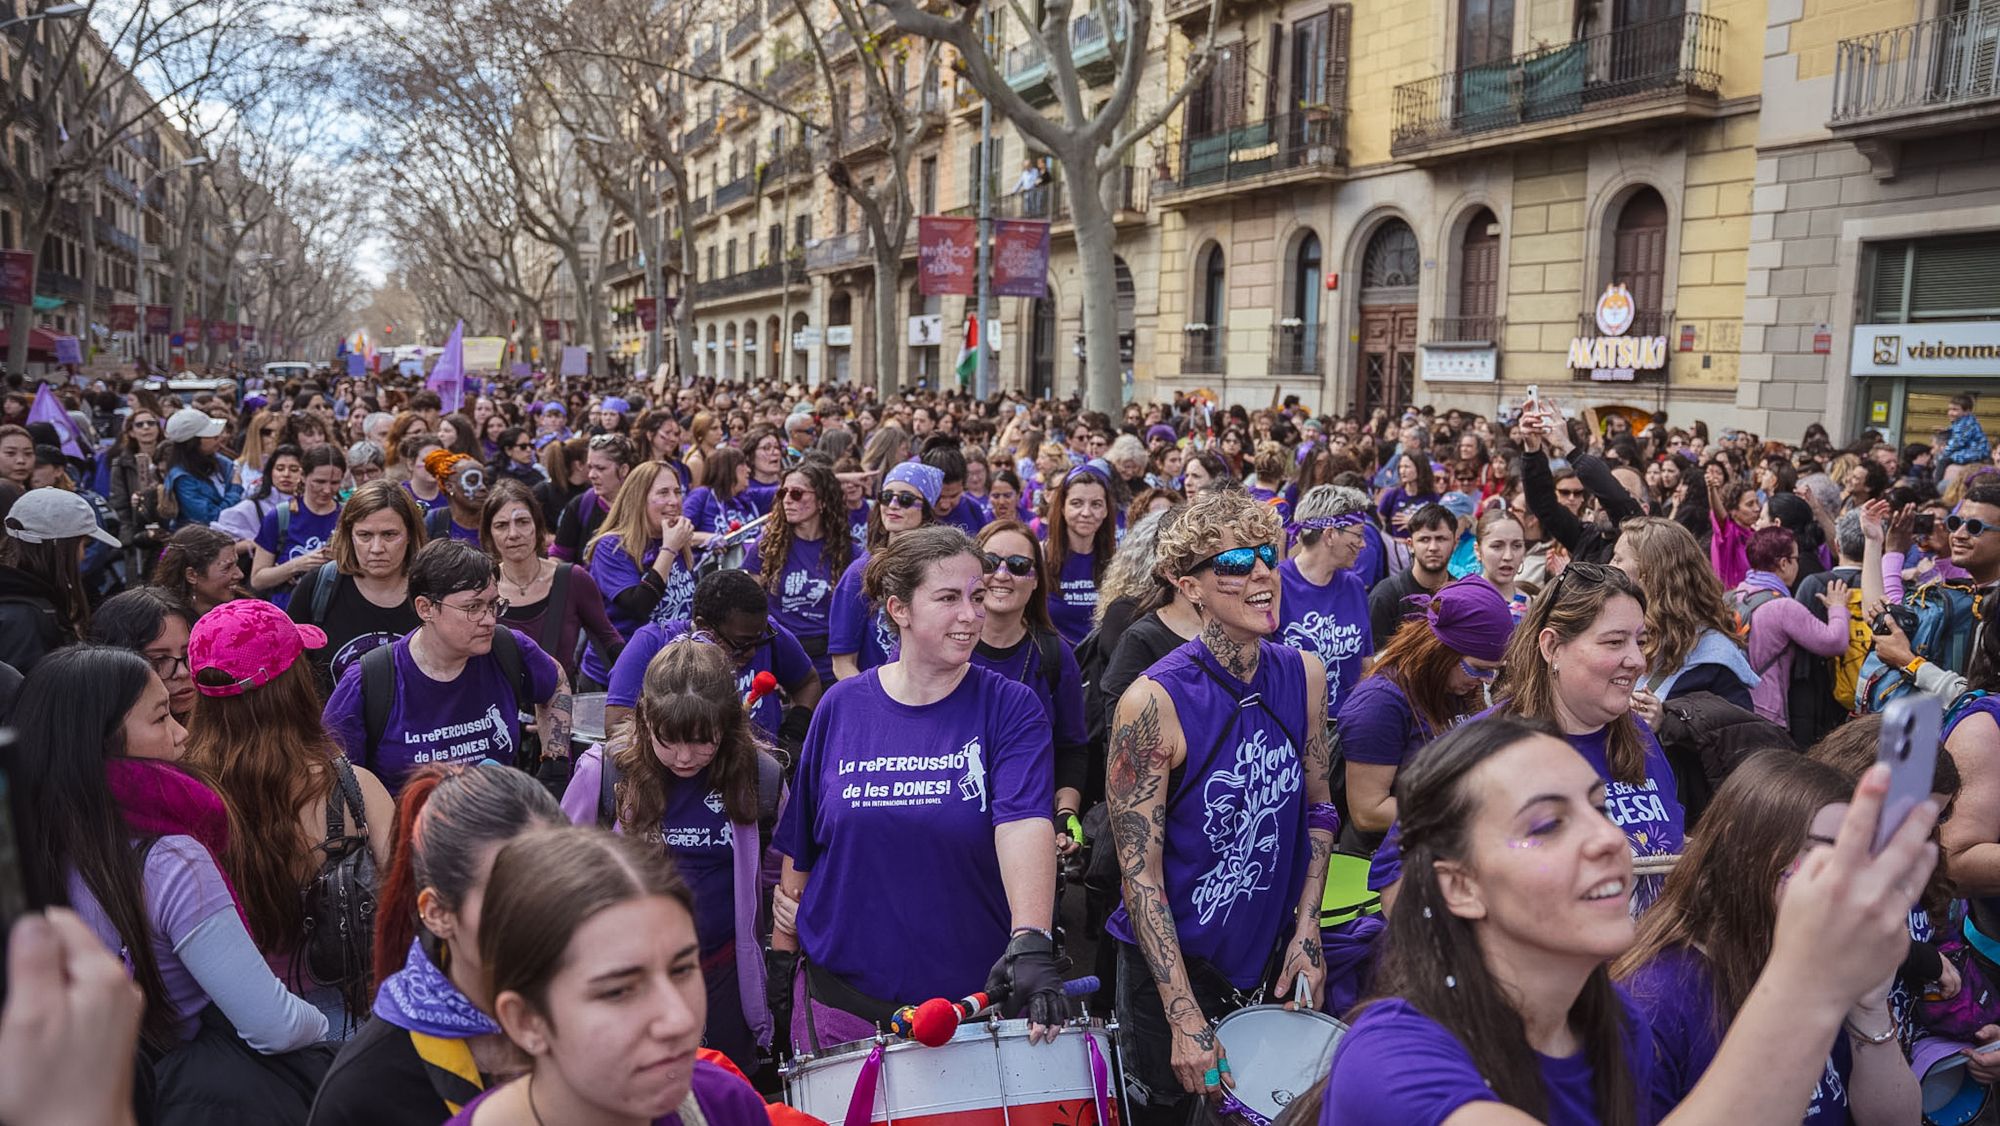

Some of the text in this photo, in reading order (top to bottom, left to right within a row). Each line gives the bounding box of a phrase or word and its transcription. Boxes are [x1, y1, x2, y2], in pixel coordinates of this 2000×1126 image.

[405, 714, 493, 744] La rePERCUSSIÓ
[414, 737, 490, 763] de les DONES!
[839, 751, 965, 776] La rePERCUSSIÓ
[842, 780, 951, 799] de les DONES!
[1613, 781, 1636, 795] SER
[871, 799, 908, 807] INTERNACIONAL
[908, 798, 916, 806] DE
